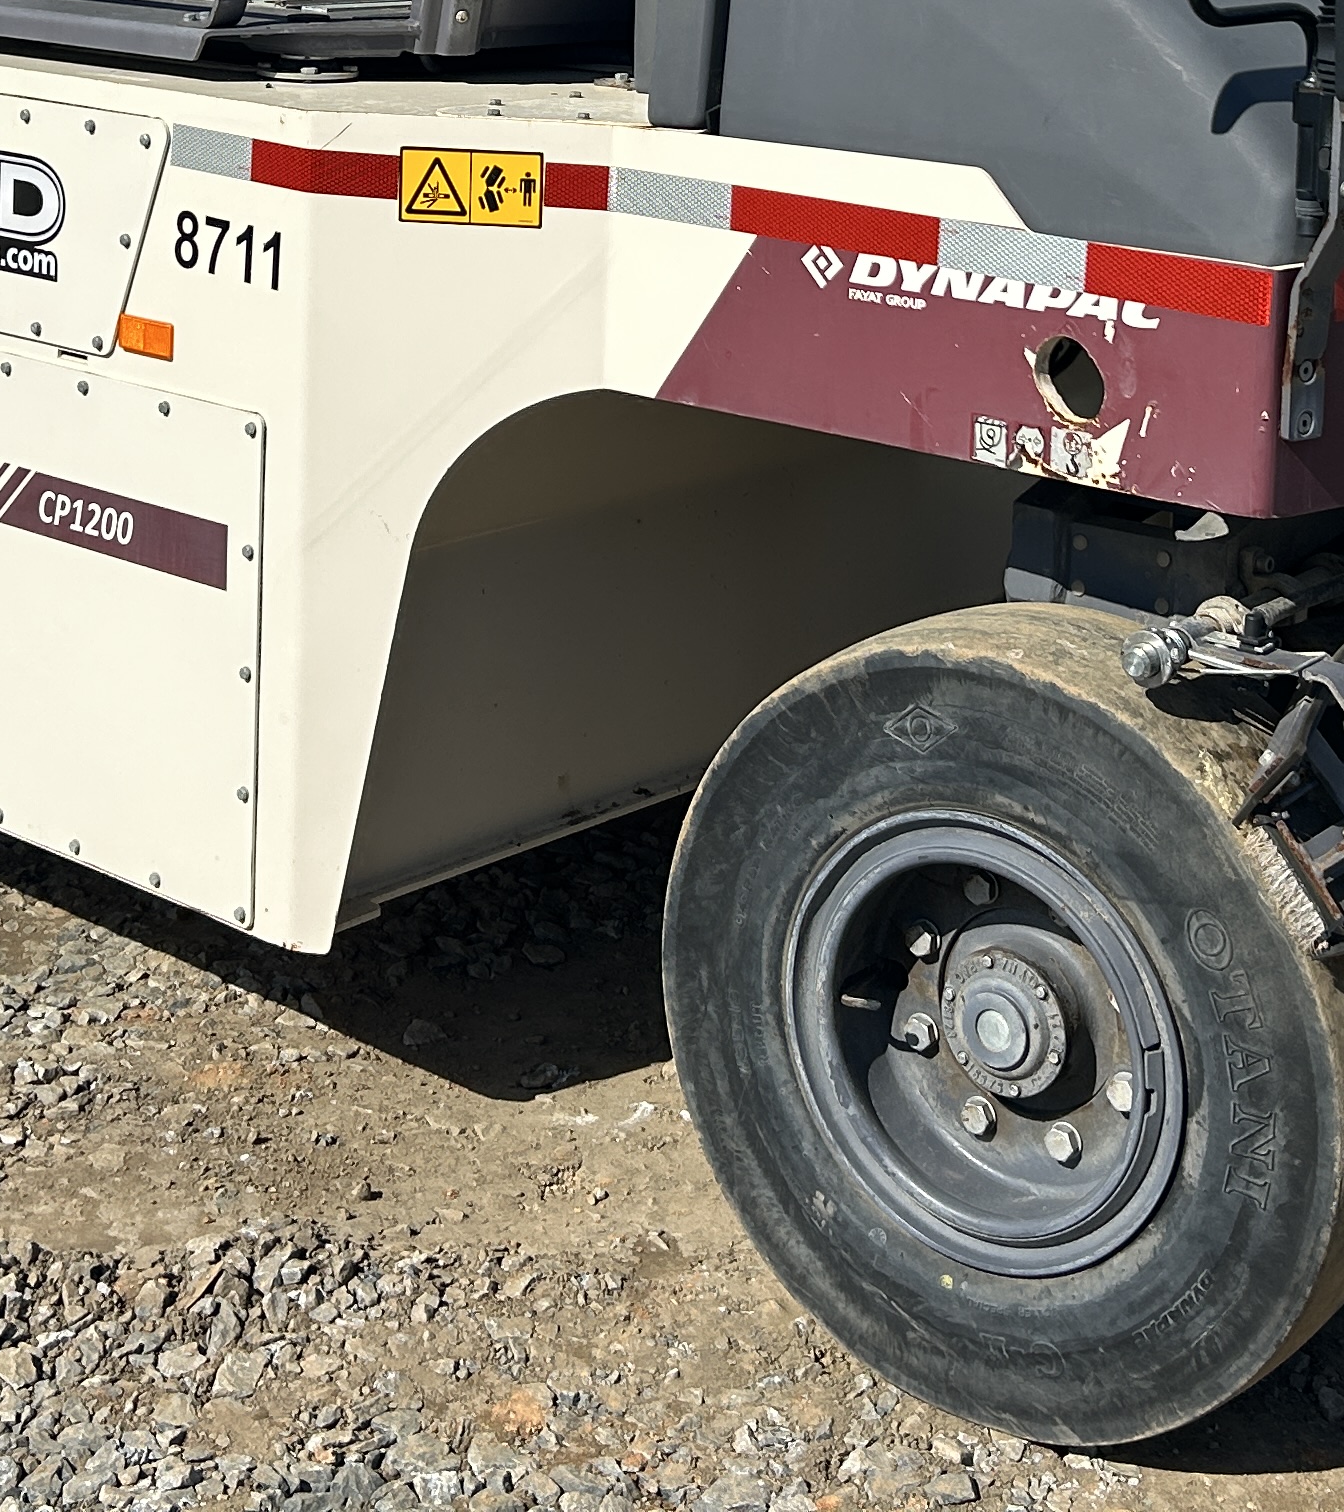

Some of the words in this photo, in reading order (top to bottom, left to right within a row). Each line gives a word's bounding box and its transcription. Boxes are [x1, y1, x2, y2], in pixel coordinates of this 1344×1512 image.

[174, 210, 282, 291] 8711
[848, 251, 1161, 330] DYNAPAC
[848, 287, 883, 305] FAYAT
[885, 293, 927, 311] GROUP
[38, 490, 134, 545] CP1200
[1183, 908, 1277, 1212] OTANI
